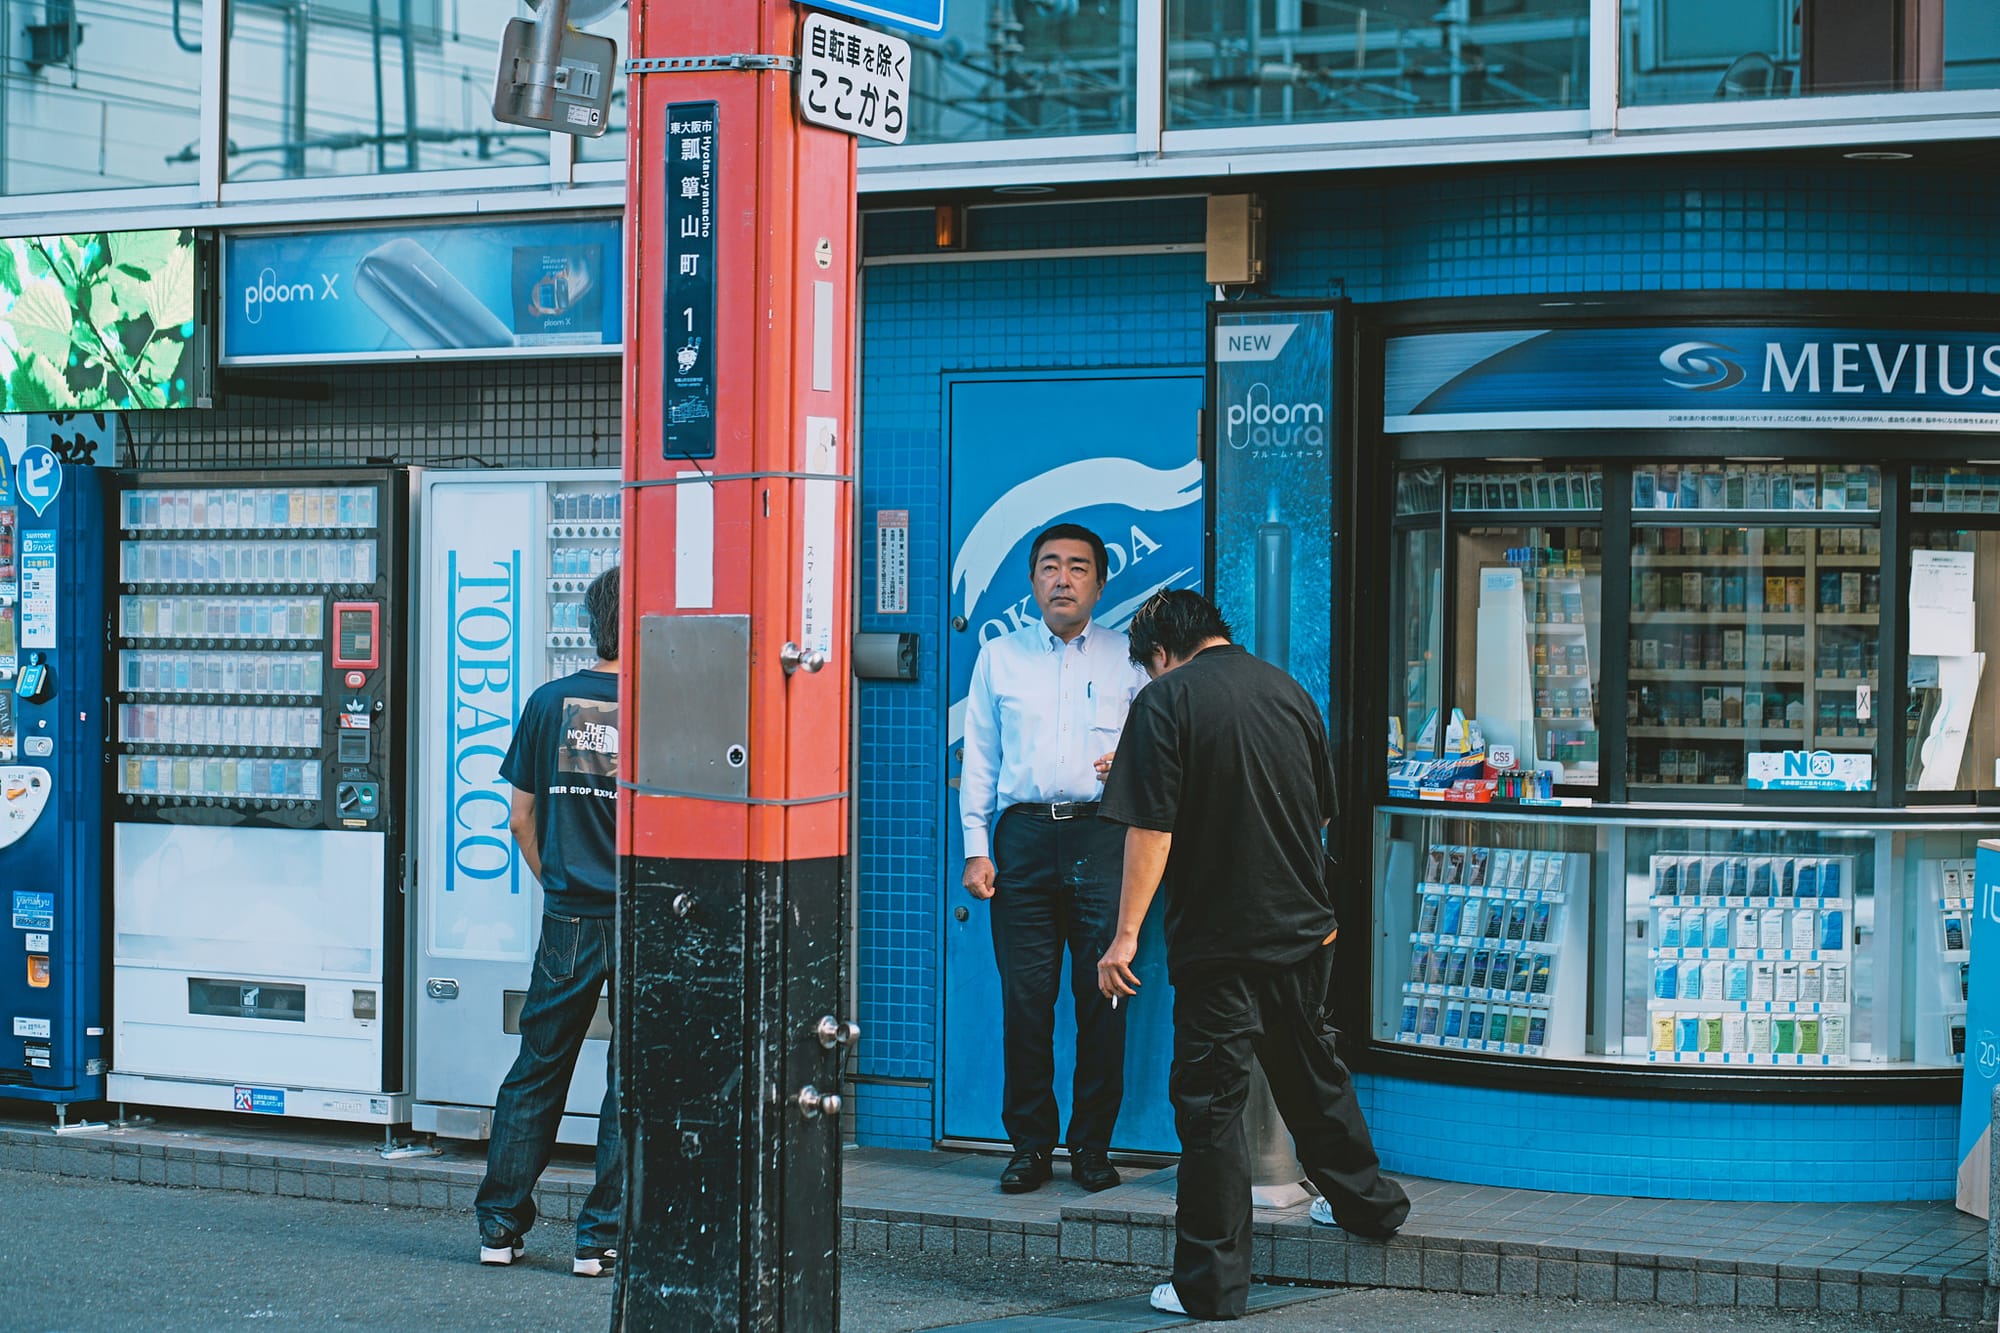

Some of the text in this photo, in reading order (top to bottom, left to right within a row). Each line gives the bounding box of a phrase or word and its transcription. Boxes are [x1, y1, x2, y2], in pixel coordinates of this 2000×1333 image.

[811, 25, 905, 82] 自転車を除く
[808, 69, 903, 134] ここから
[591, 112, 598, 122] C
[670, 120, 713, 135] 東大阪市
[700, 136, 712, 238] Hyotan-yamacho
[245, 267, 339, 324] ploom X
[1229, 335, 1271, 352] NEW
[1762, 342, 2000, 397] MEVIUS
[1228, 382, 1324, 450] ploom
[1252, 425, 1324, 447] aura
[25, 453, 54, 496] ピ
[455, 561, 511, 880] TOBACCO
[584, 722, 606, 734] THE
[567, 730, 604, 743] NORTH
[577, 740, 603, 752] FACE
[1493, 751, 1510, 763] CS5
[570, 786, 592, 795] STOP
